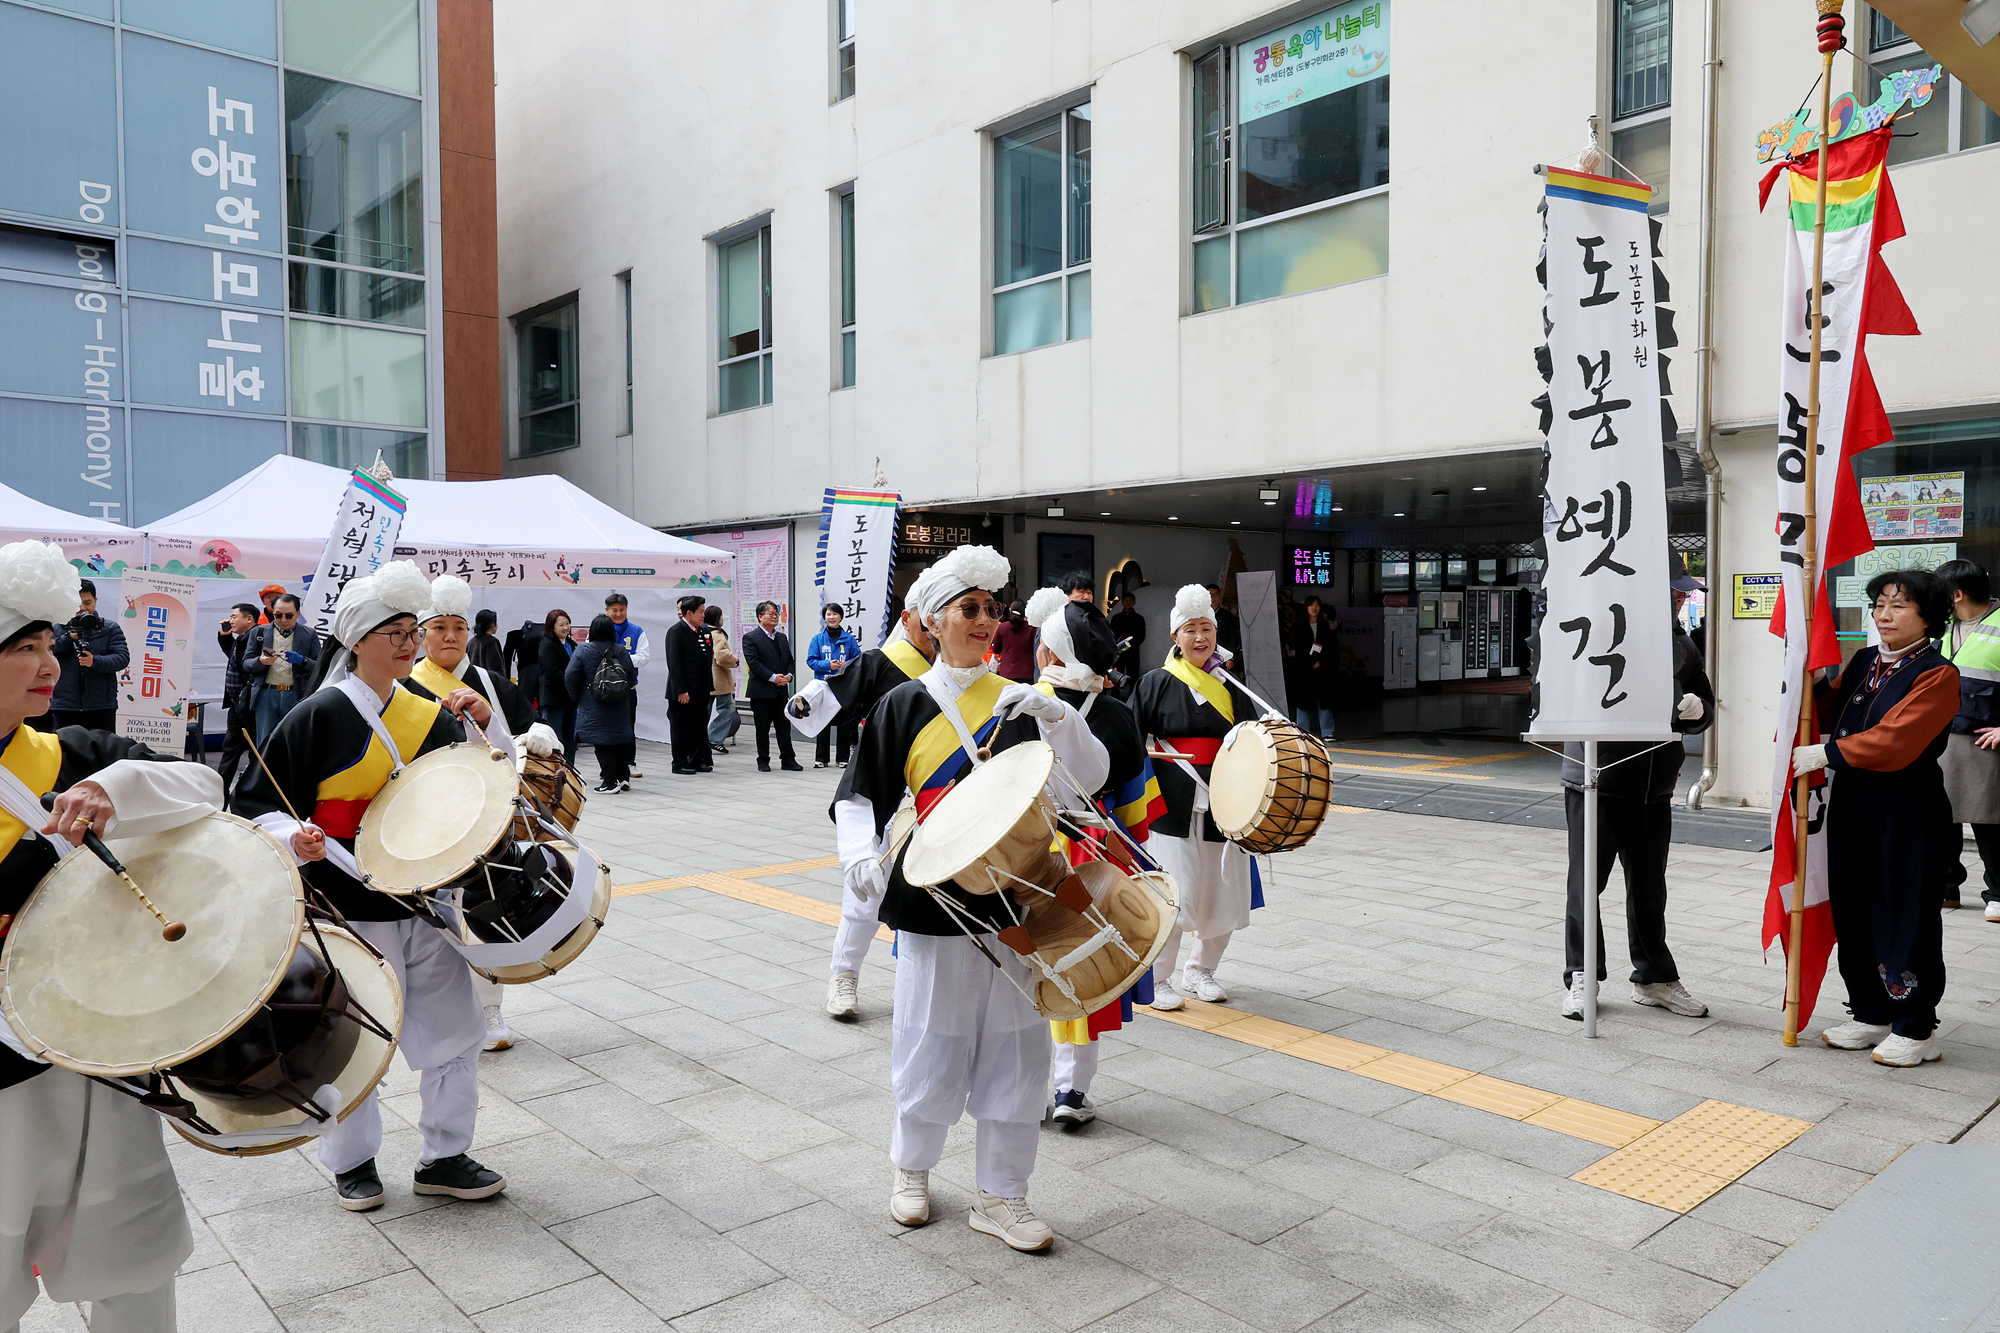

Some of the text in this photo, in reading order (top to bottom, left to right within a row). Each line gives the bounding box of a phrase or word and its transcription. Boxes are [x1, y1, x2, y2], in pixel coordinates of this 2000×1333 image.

[1253, 2, 1381, 74] 공동육아 나눔터
[1255, 65, 1294, 86] 가족센터점
[191, 86, 265, 407] 도봉하모니홀
[1628, 241, 1648, 368] 도봉문화원
[905, 524, 971, 544] 도봉갤러리
[367, 516, 392, 574] 민속놀
[900, 547, 936, 555] DOBONG
[1294, 548, 1331, 567] 온도 습도
[1857, 546, 1950, 575] GS 25
[428, 558, 525, 584] 민속놀이
[623, 636, 632, 650] 1
[840, 644, 845, 654] 1
[126, 719, 172, 729] 2026.3.3.(화)
[126, 726, 171, 735] 11:00~16:00
